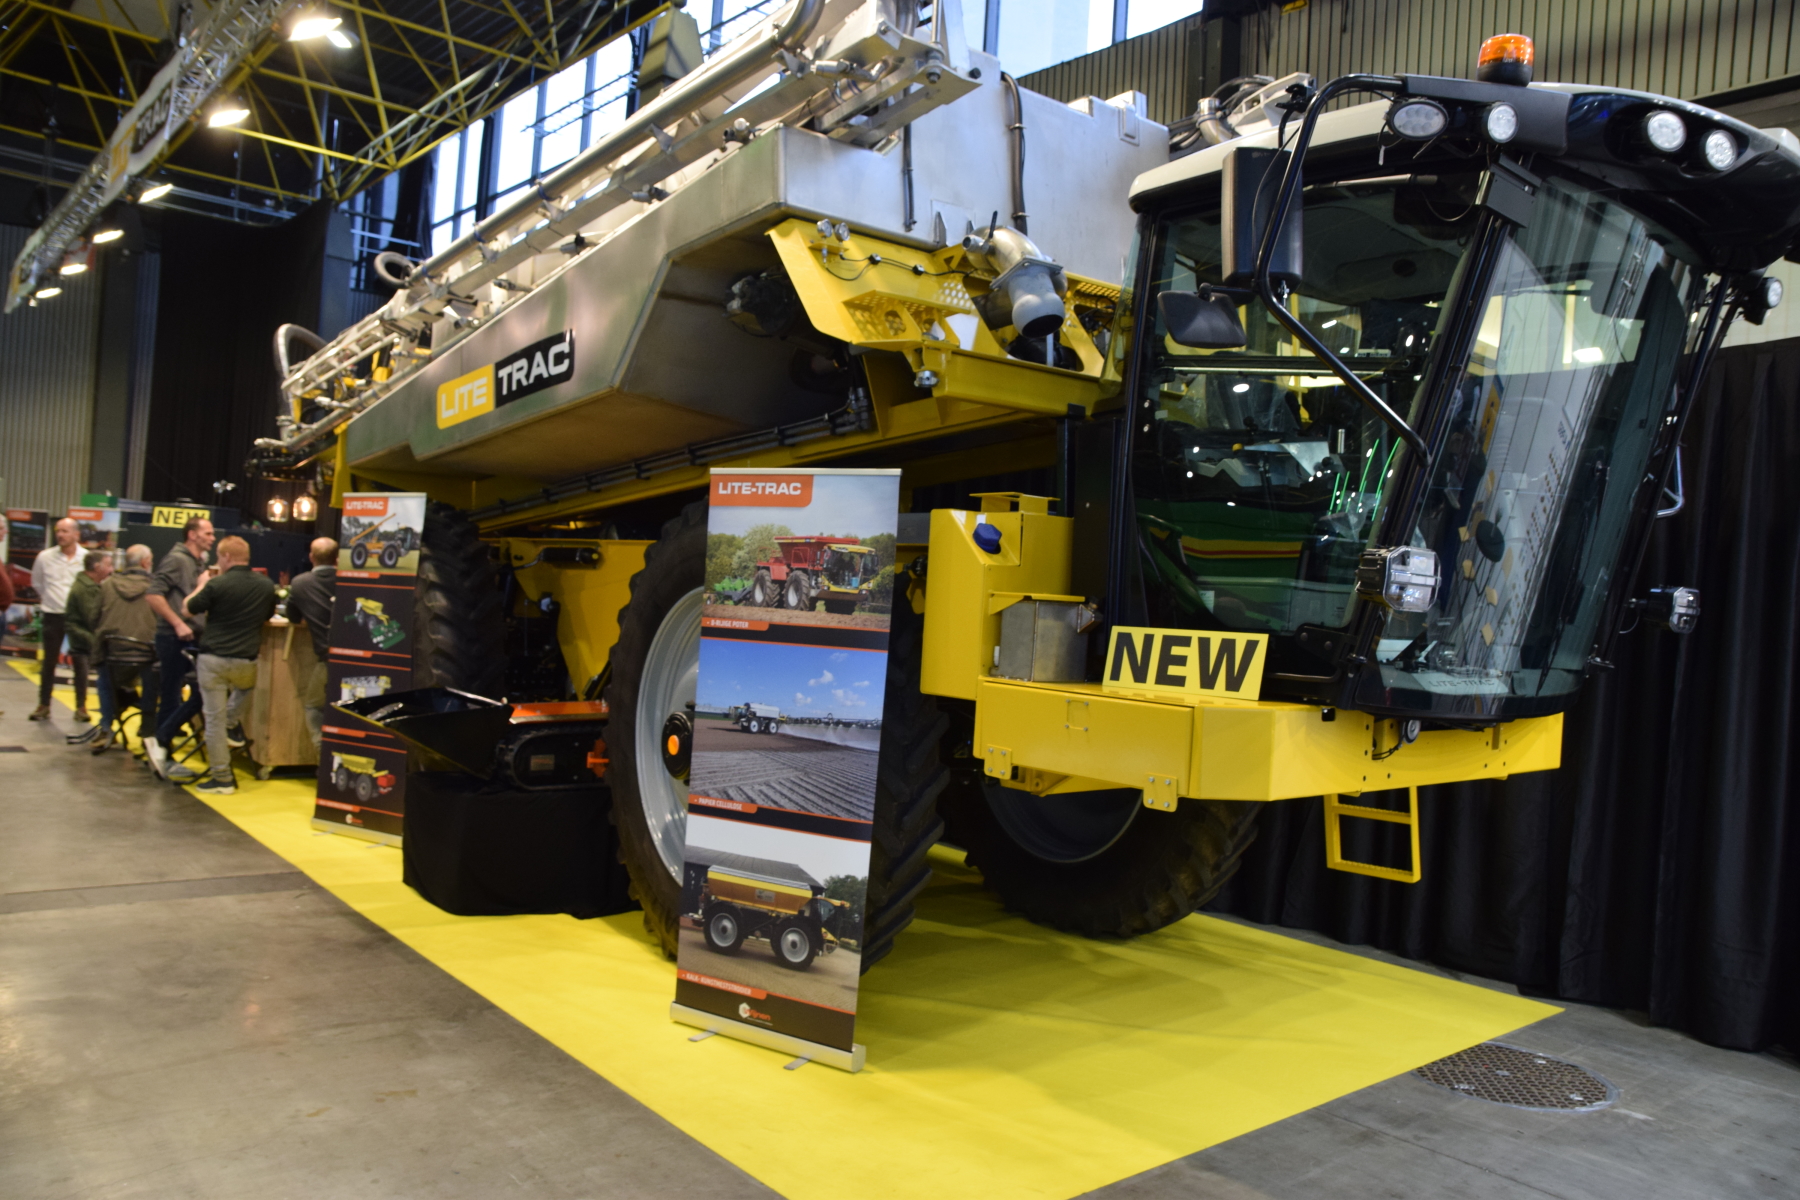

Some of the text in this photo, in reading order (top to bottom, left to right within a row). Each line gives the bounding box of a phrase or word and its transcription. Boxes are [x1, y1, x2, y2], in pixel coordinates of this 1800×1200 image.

[441, 341, 570, 419] LITE TRAC
[346, 501, 384, 510] LITE-TRAC
[718, 482, 802, 495] LITE-TRAC
[1109, 632, 1260, 692] NEW
